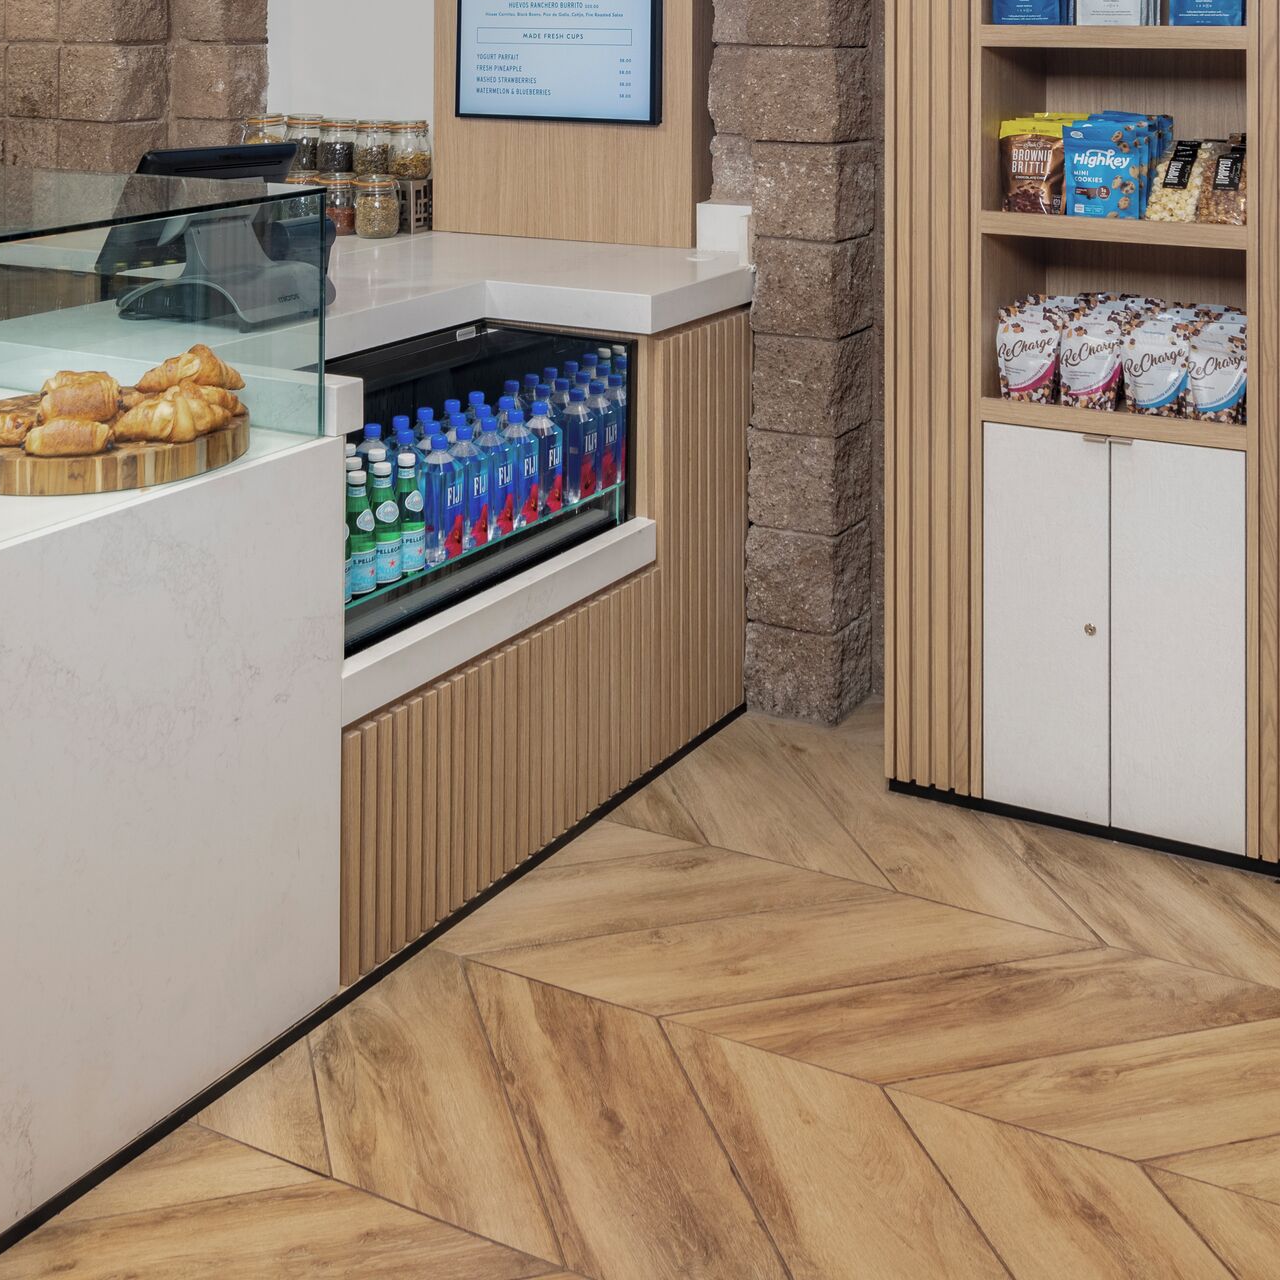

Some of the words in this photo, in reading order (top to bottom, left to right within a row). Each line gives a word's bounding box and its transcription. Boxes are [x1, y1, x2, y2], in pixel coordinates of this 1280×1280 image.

[1123, 348, 1185, 378] ReCharge
[524, 455, 539, 477] FIJI
[548, 445, 563, 468] FIJI
[498, 463, 513, 486] FIJI
[447, 482, 463, 507] FIJI
